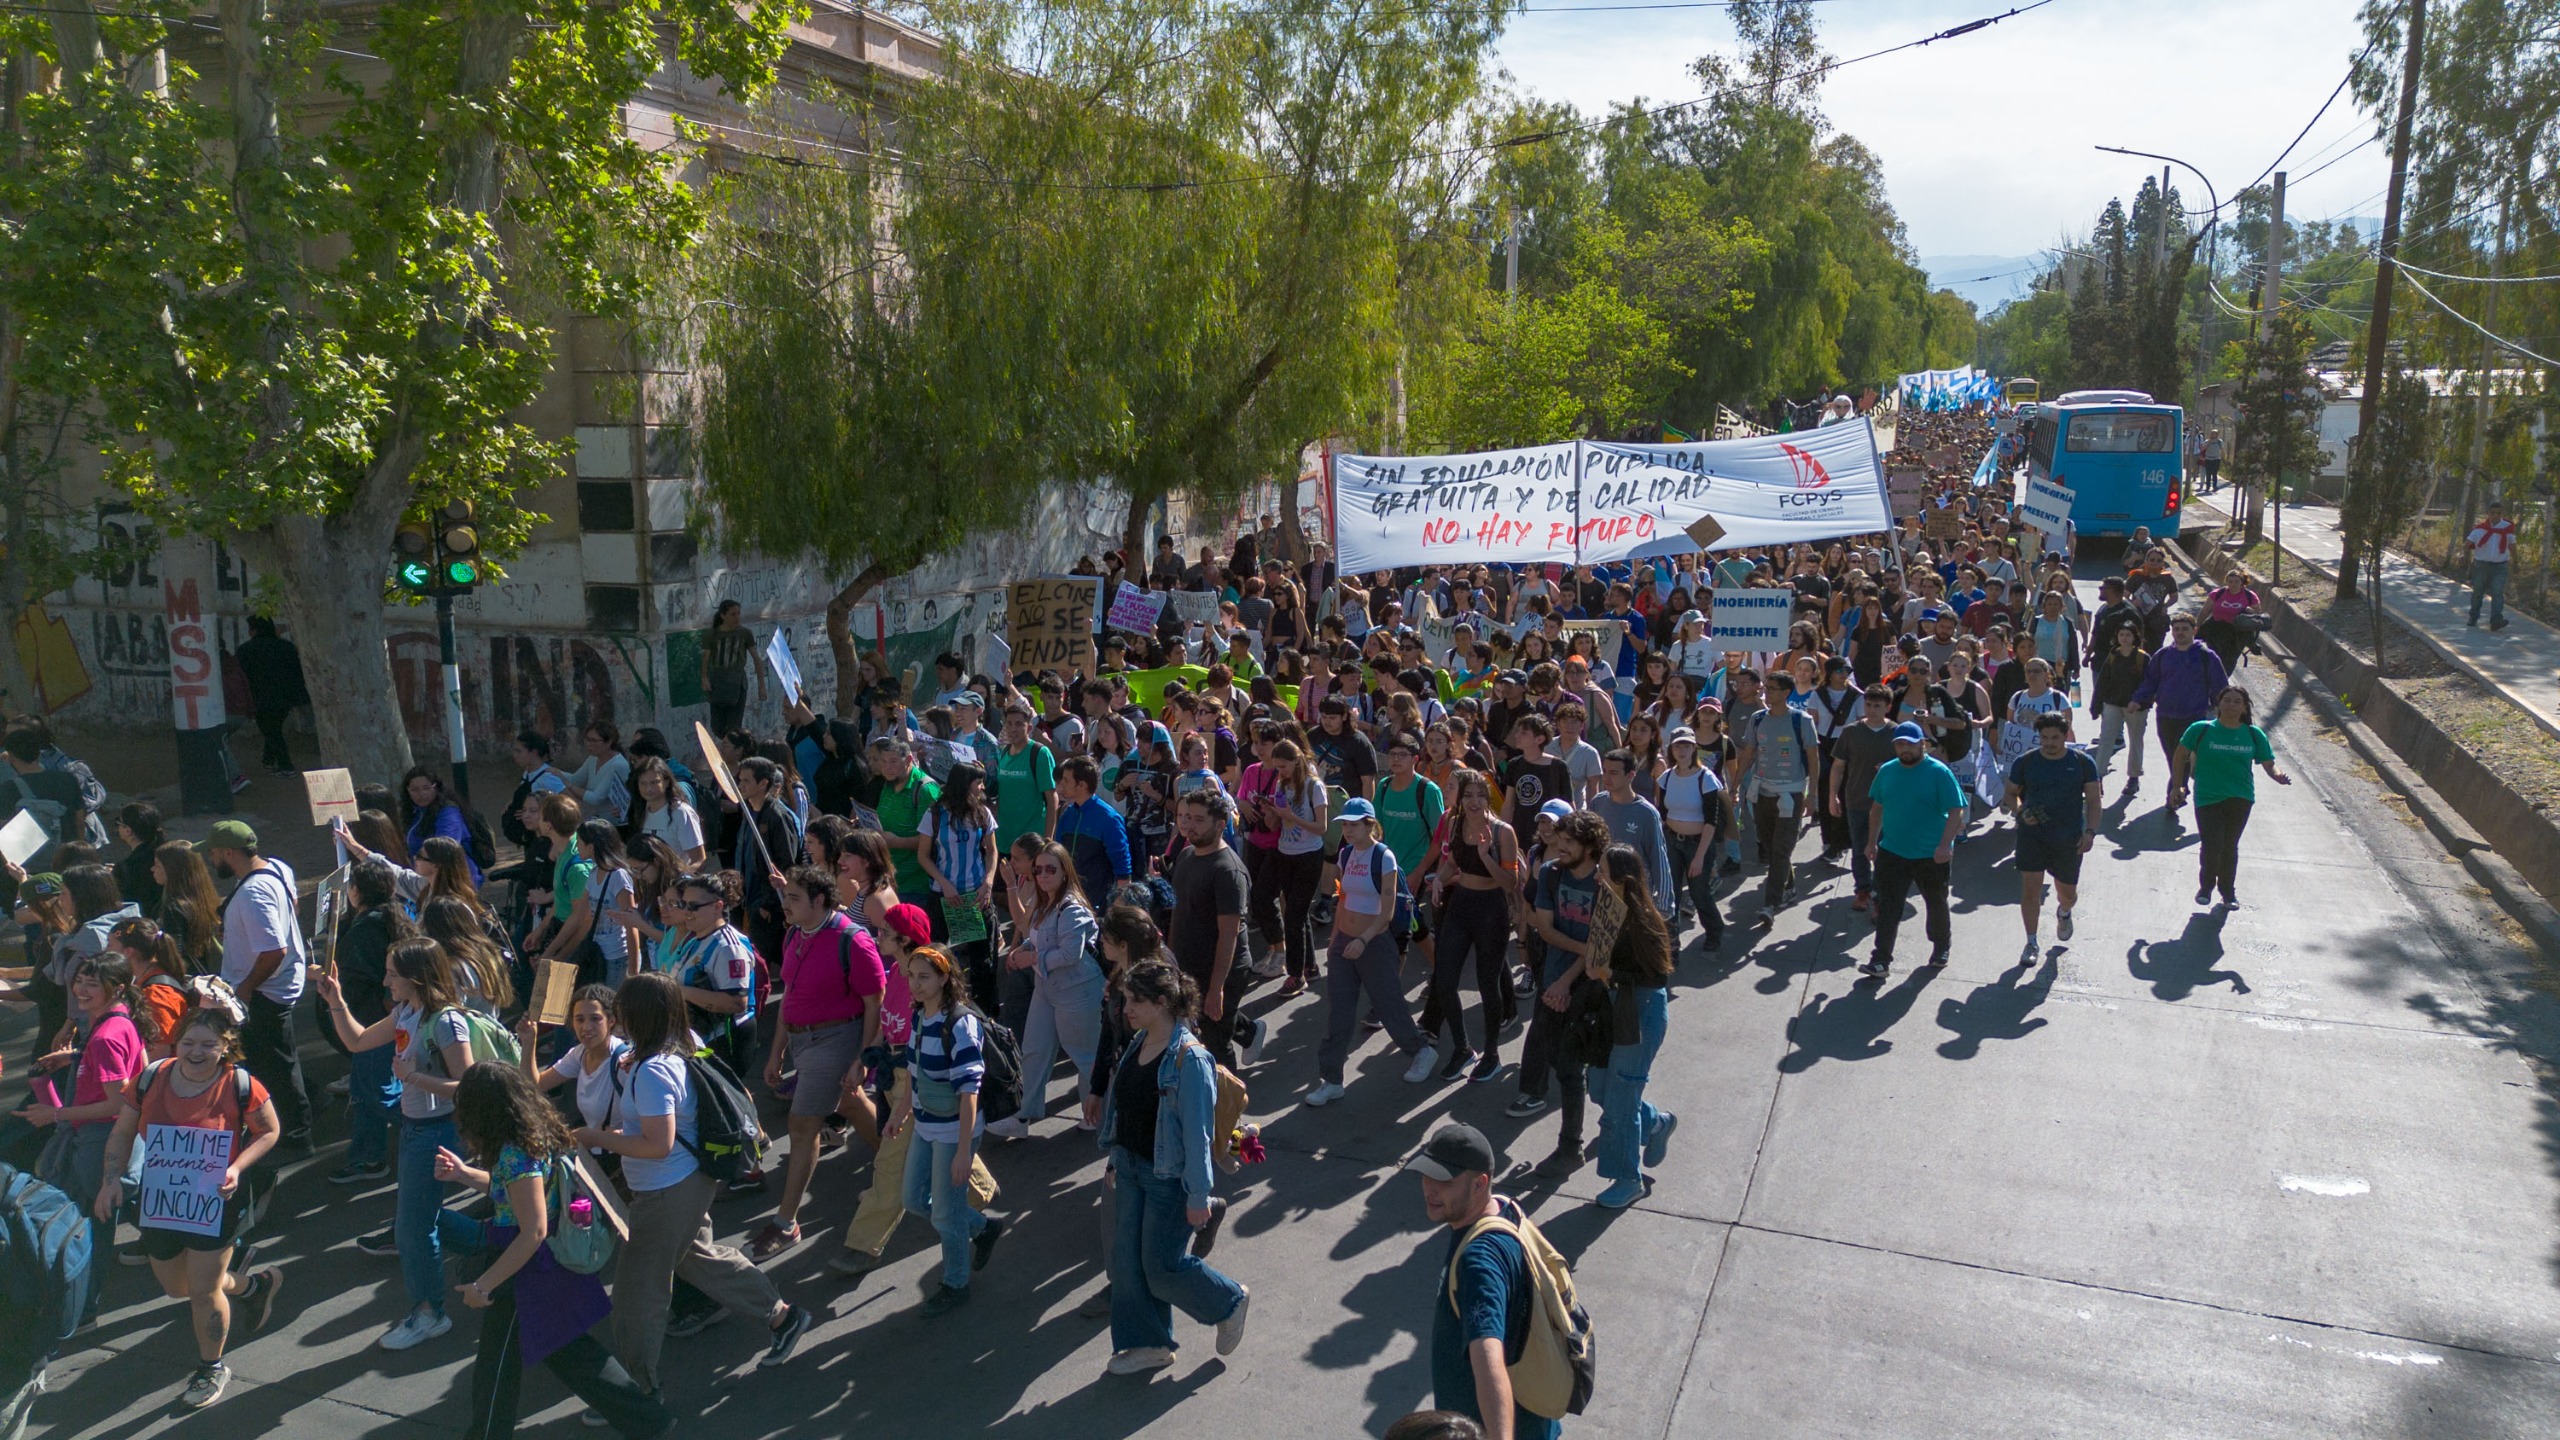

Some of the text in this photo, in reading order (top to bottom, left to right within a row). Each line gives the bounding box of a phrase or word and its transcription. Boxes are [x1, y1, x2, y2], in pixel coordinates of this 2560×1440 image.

[1363, 463, 1406, 487] SIN
[1421, 450, 1572, 486] EDUCACIÓN
[2140, 469, 2165, 484] 146
[1372, 475, 1711, 521] GRATUITA Y DE CALIDAD
[1779, 489, 1843, 508] FCPyS
[2031, 481, 2073, 503] INGENIERÍA
[2023, 504, 2060, 524] PRESENTE
[1422, 512, 1655, 551] NO HAY FUTURO
[702, 569, 782, 609] VOTA
[1016, 583, 1095, 606] EL CINE
[1713, 595, 1788, 608] INGENIERÍA
[1018, 605, 1084, 631] NO SE
[1713, 627, 1779, 637] PRESENTE
[165, 577, 217, 731] MST
[1009, 635, 1087, 668] VENDE
[2009, 726, 2022, 739] LA
[2003, 739, 2023, 754] NO
[955, 829, 970, 844] 10
[148, 1128, 231, 1158] A MÍ ME
[146, 1153, 223, 1173] inventó
[169, 1173, 191, 1186] LA
[143, 1187, 221, 1223] UNCUYO
